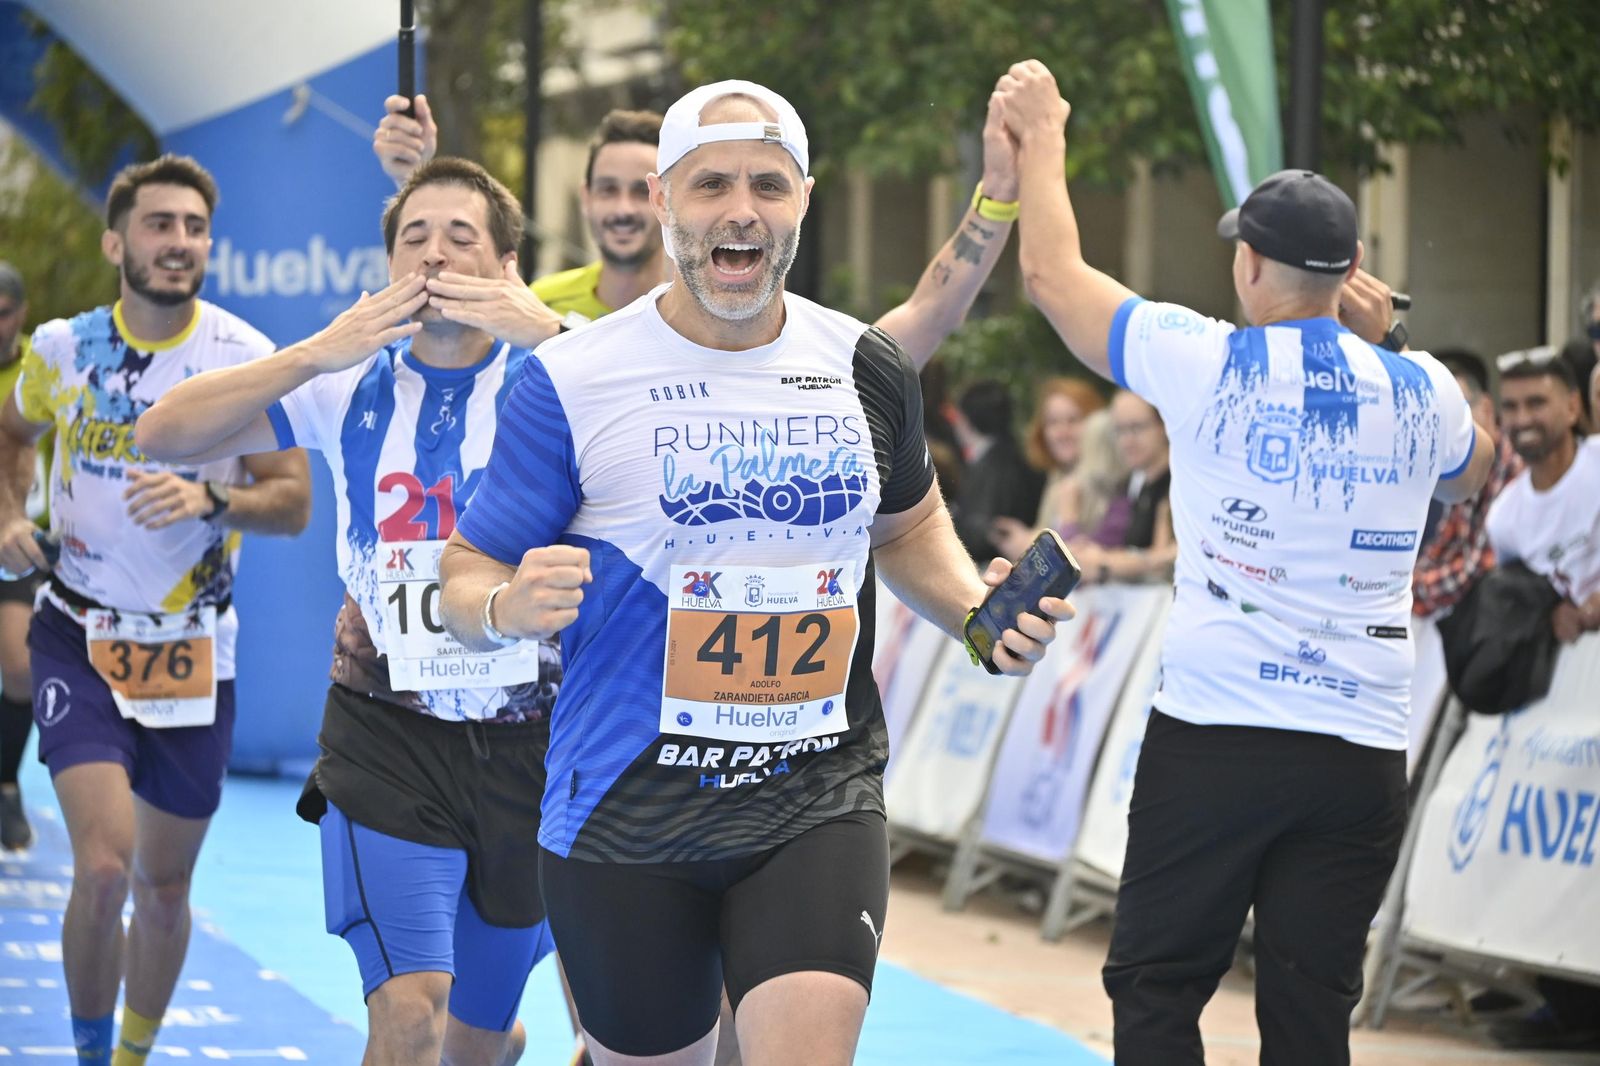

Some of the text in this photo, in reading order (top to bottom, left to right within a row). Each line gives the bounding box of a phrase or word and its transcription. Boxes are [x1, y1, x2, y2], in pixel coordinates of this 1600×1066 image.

[203, 234, 388, 298] Huelva
[650, 382, 710, 402] GOBIK
[781, 377, 803, 385] BAR
[798, 383, 832, 391] HUELVA
[654, 414, 861, 457] RUNNERS
[663, 427, 864, 500] la Palmera
[1311, 463, 1399, 485] HUELVA
[1211, 513, 1275, 540] HYUNDAI
[1356, 531, 1416, 547] DECATHLON
[385, 547, 415, 571] 21K
[682, 571, 724, 600] 21K
[681, 597, 723, 609] HUELVA
[766, 595, 799, 605] HUELVA
[816, 594, 847, 608] HUELVA
[696, 613, 832, 677] 412
[109, 639, 194, 683] 376
[420, 658, 490, 678] Huelva
[750, 680, 781, 689] ADOLFO
[713, 690, 810, 703] ZARANDIETA GARCIA
[715, 704, 798, 727] Huelva
[657, 743, 725, 769] BAR
